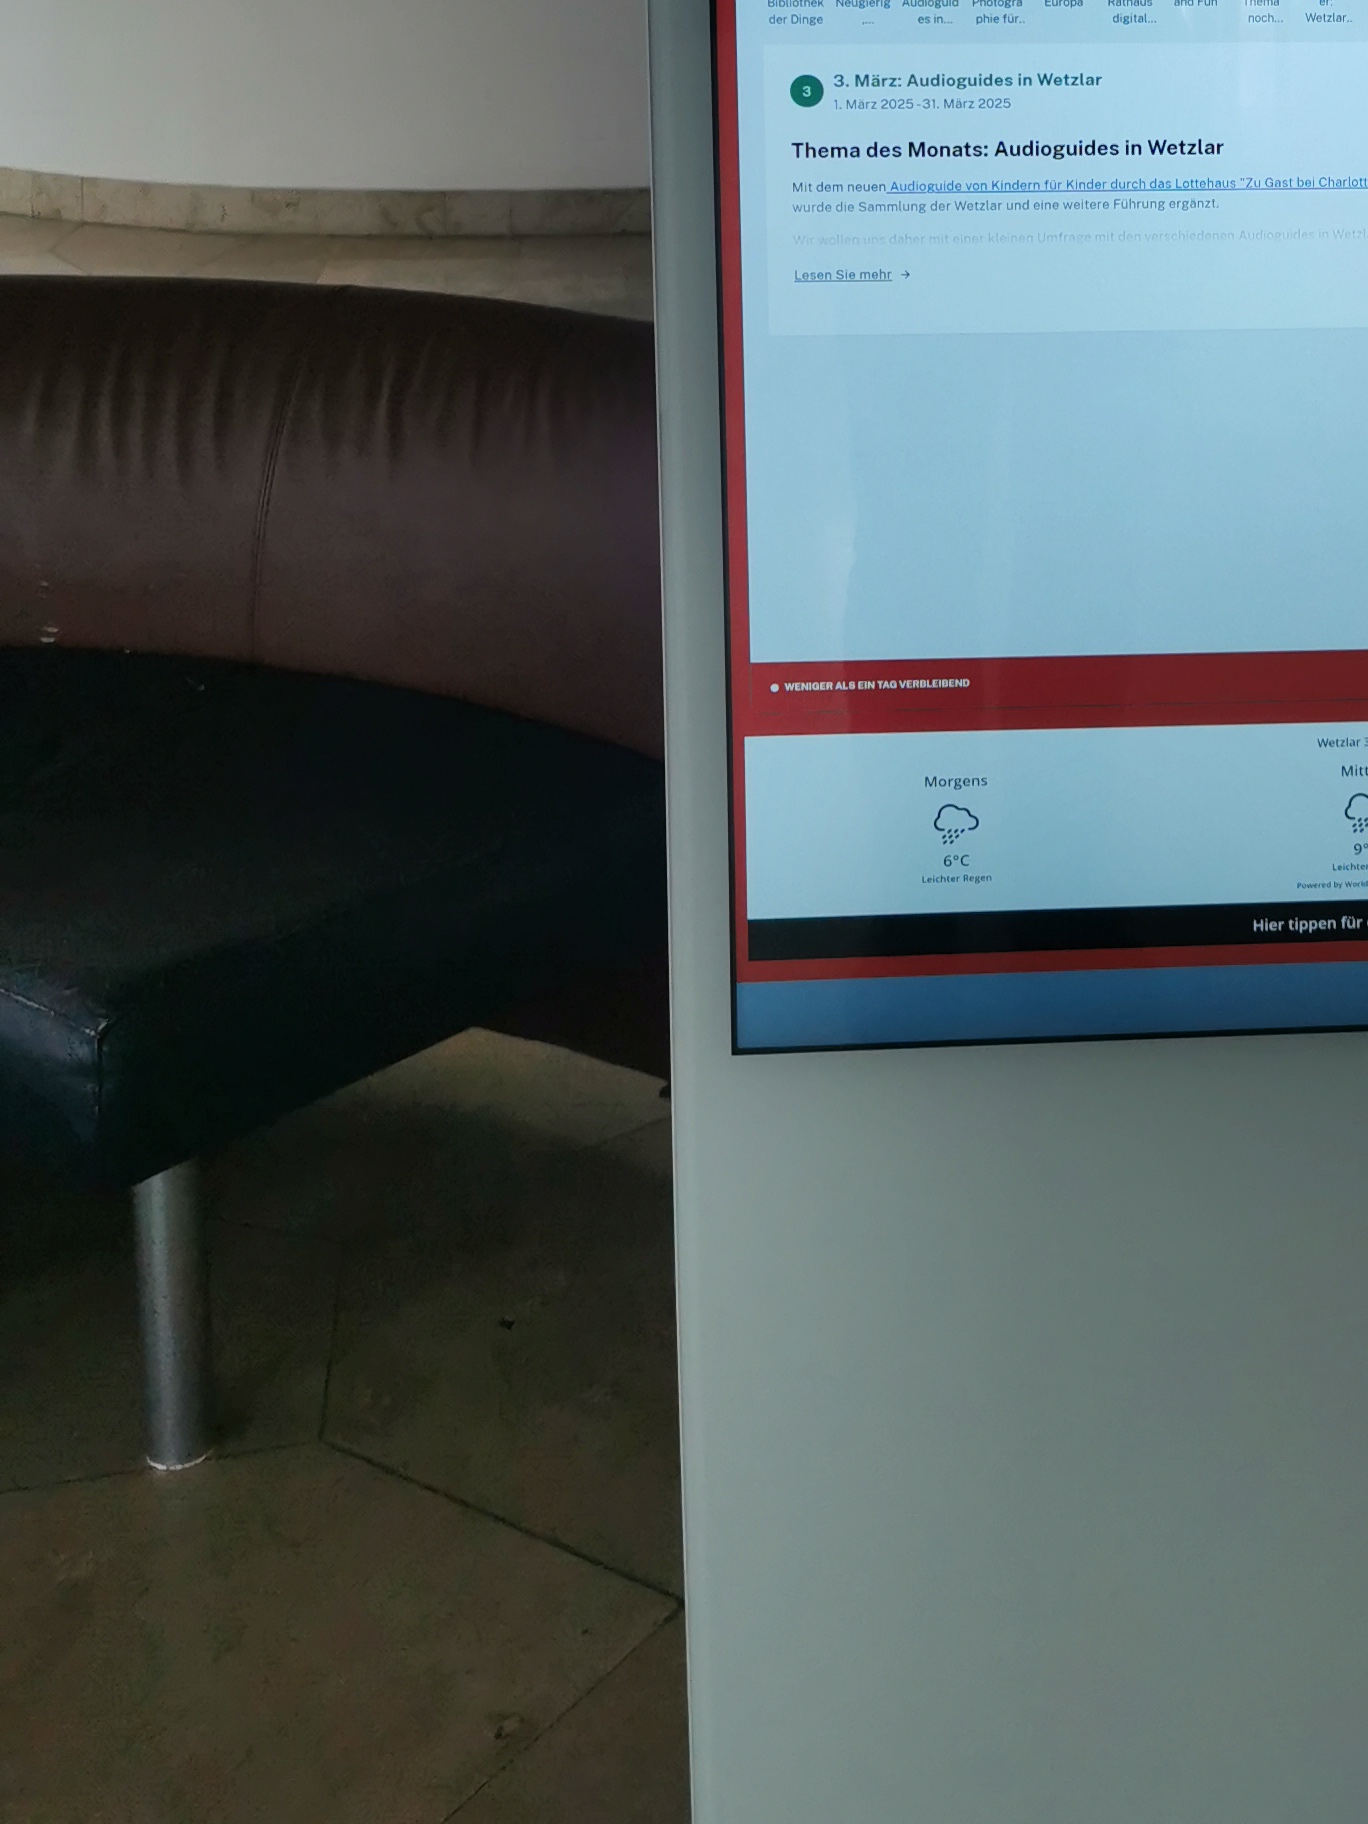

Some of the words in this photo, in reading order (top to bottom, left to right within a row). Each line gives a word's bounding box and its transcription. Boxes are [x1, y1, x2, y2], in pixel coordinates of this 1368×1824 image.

[768, 14, 788, 25] der
[791, 14, 824, 27] Dinge
[833, 74, 850, 88] 3.
[854, 73, 902, 88] März:
[906, 73, 1014, 90] Audioguides
[1018, 73, 1033, 87] in
[1036, 72, 1103, 87] Wetzlar
[790, 141, 861, 159] Thema
[866, 140, 902, 158] des
[908, 140, 988, 158] Monats:
[994, 138, 1120, 161] Audioguides
[1125, 139, 1142, 156] in
[1147, 138, 1225, 156] Wetzlar
[794, 269, 833, 281] Lesen
[835, 268, 856, 281] Sie
[859, 268, 893, 281] mehr
[784, 681, 834, 692] WENIGER
[834, 680, 856, 691] ALS
[857, 680, 876, 691] EIN
[876, 679, 898, 690] TAG
[898, 678, 971, 690] VERBLEIBEND
[1316, 737, 1362, 749] Wetzlar
[924, 775, 988, 791] Morgens
[943, 854, 970, 867] 6°C
[921, 874, 961, 884] Leichter
[962, 873, 993, 885] Regen
[1296, 880, 1332, 890] Powered
[1333, 880, 1344, 890] by
[1344, 879, 1368, 889] World
[1253, 917, 1285, 933] Hier
[1288, 915, 1337, 935] tippen
[1340, 915, 1364, 930] für
